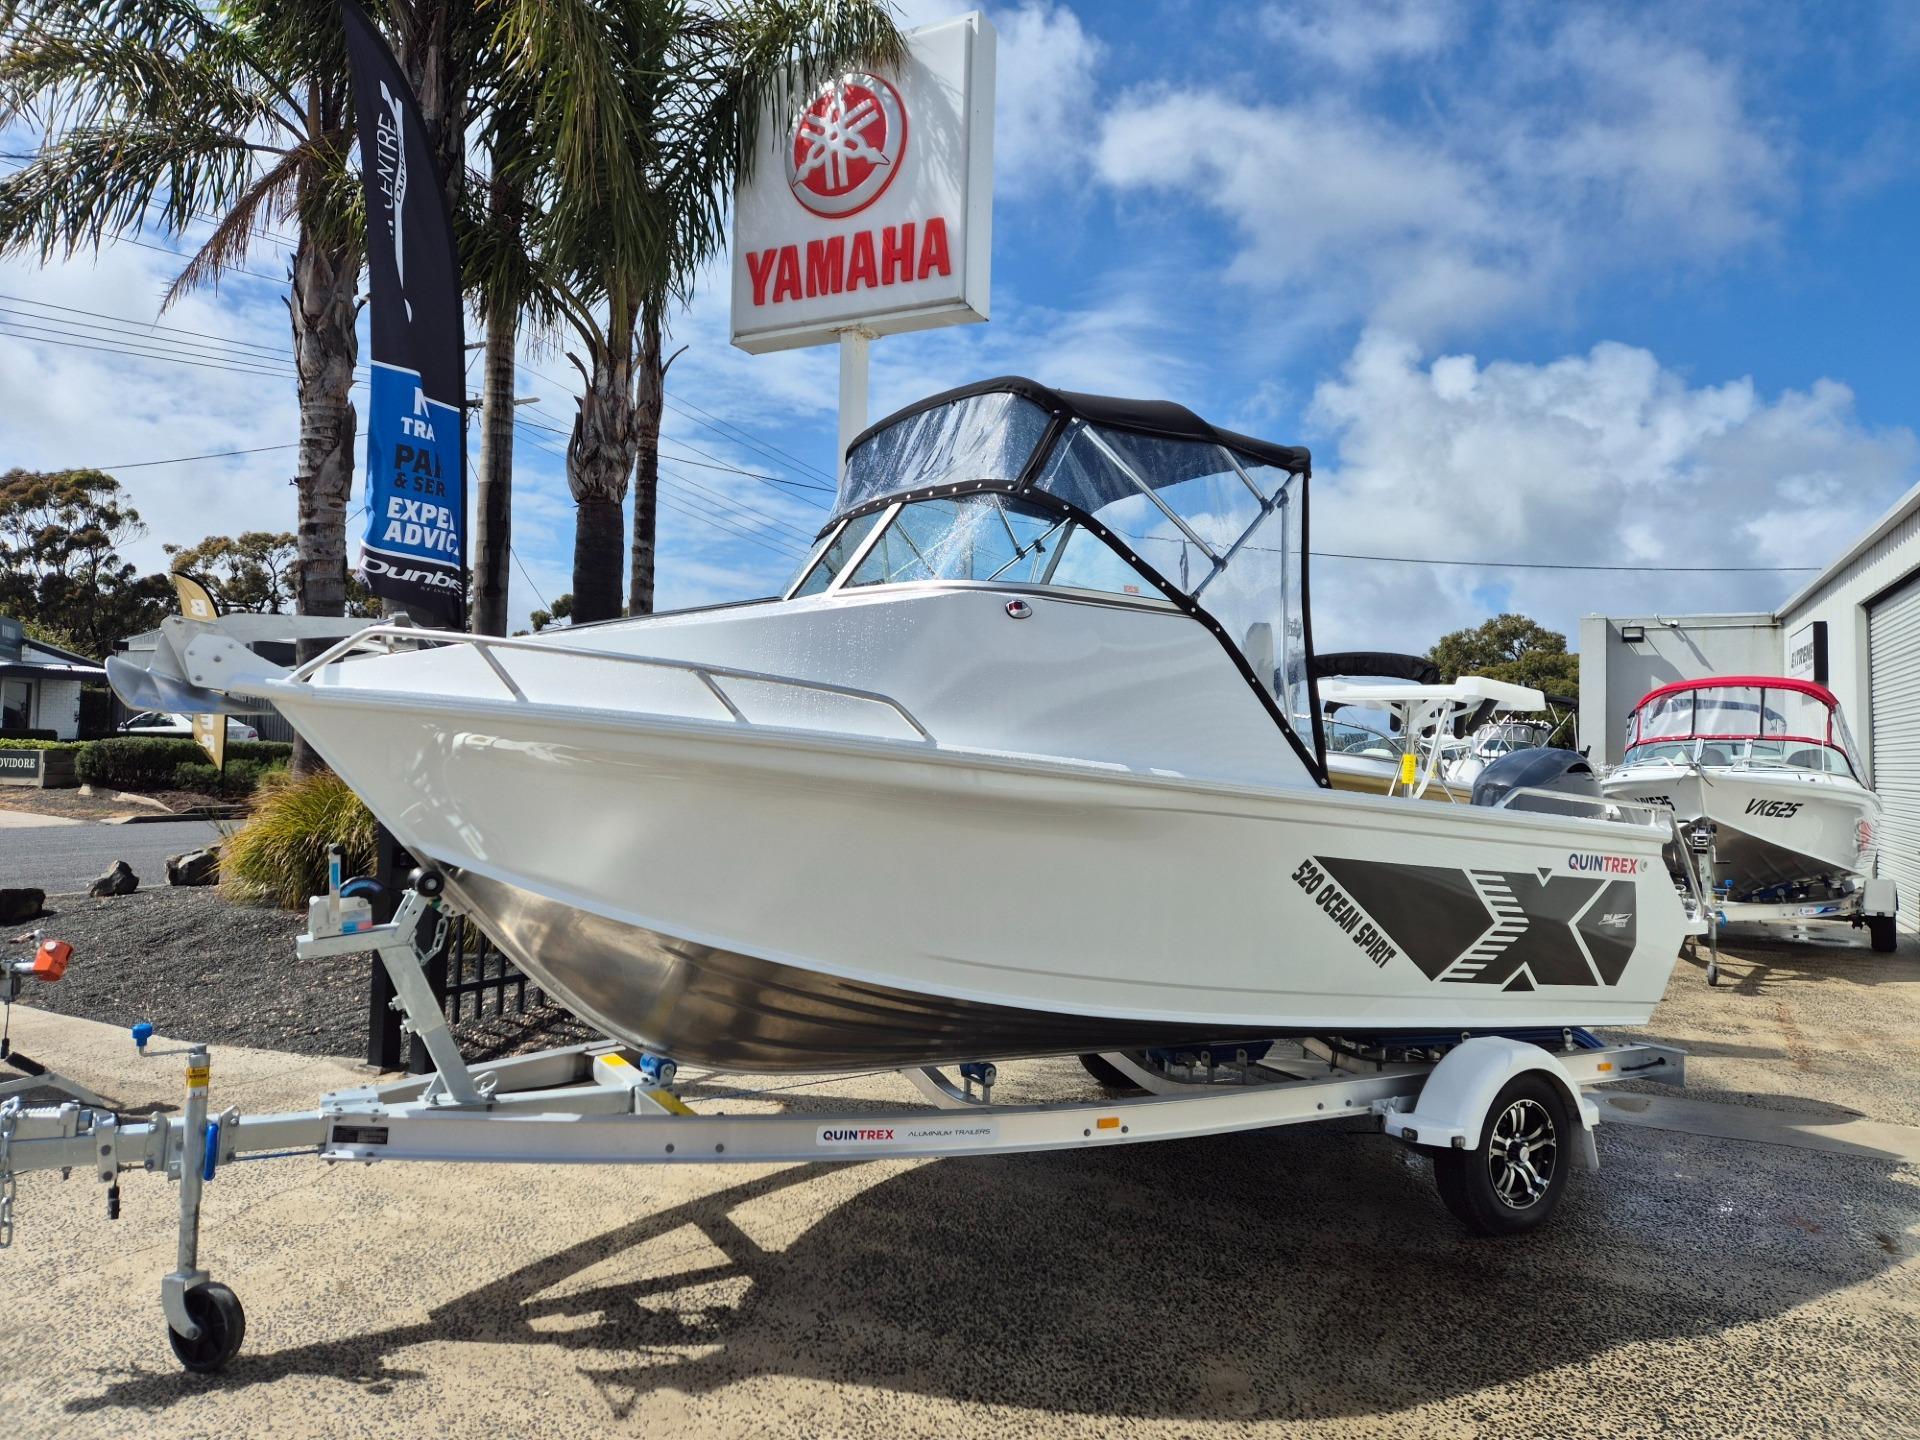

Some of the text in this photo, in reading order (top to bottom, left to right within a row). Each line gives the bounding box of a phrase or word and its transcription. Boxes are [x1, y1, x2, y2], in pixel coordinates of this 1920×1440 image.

[746, 217, 951, 306] YAMAHA
[394, 471, 407, 489] &
[383, 520, 460, 556] ADVIC
[1745, 798, 1803, 818] VK625
[1568, 853, 1638, 874] QUINTREX
[1291, 859, 1397, 968] 520 OCEAN SPIRIT
[823, 1129, 894, 1141] QUINTREX
[954, 1128, 991, 1136] TRAILERS
